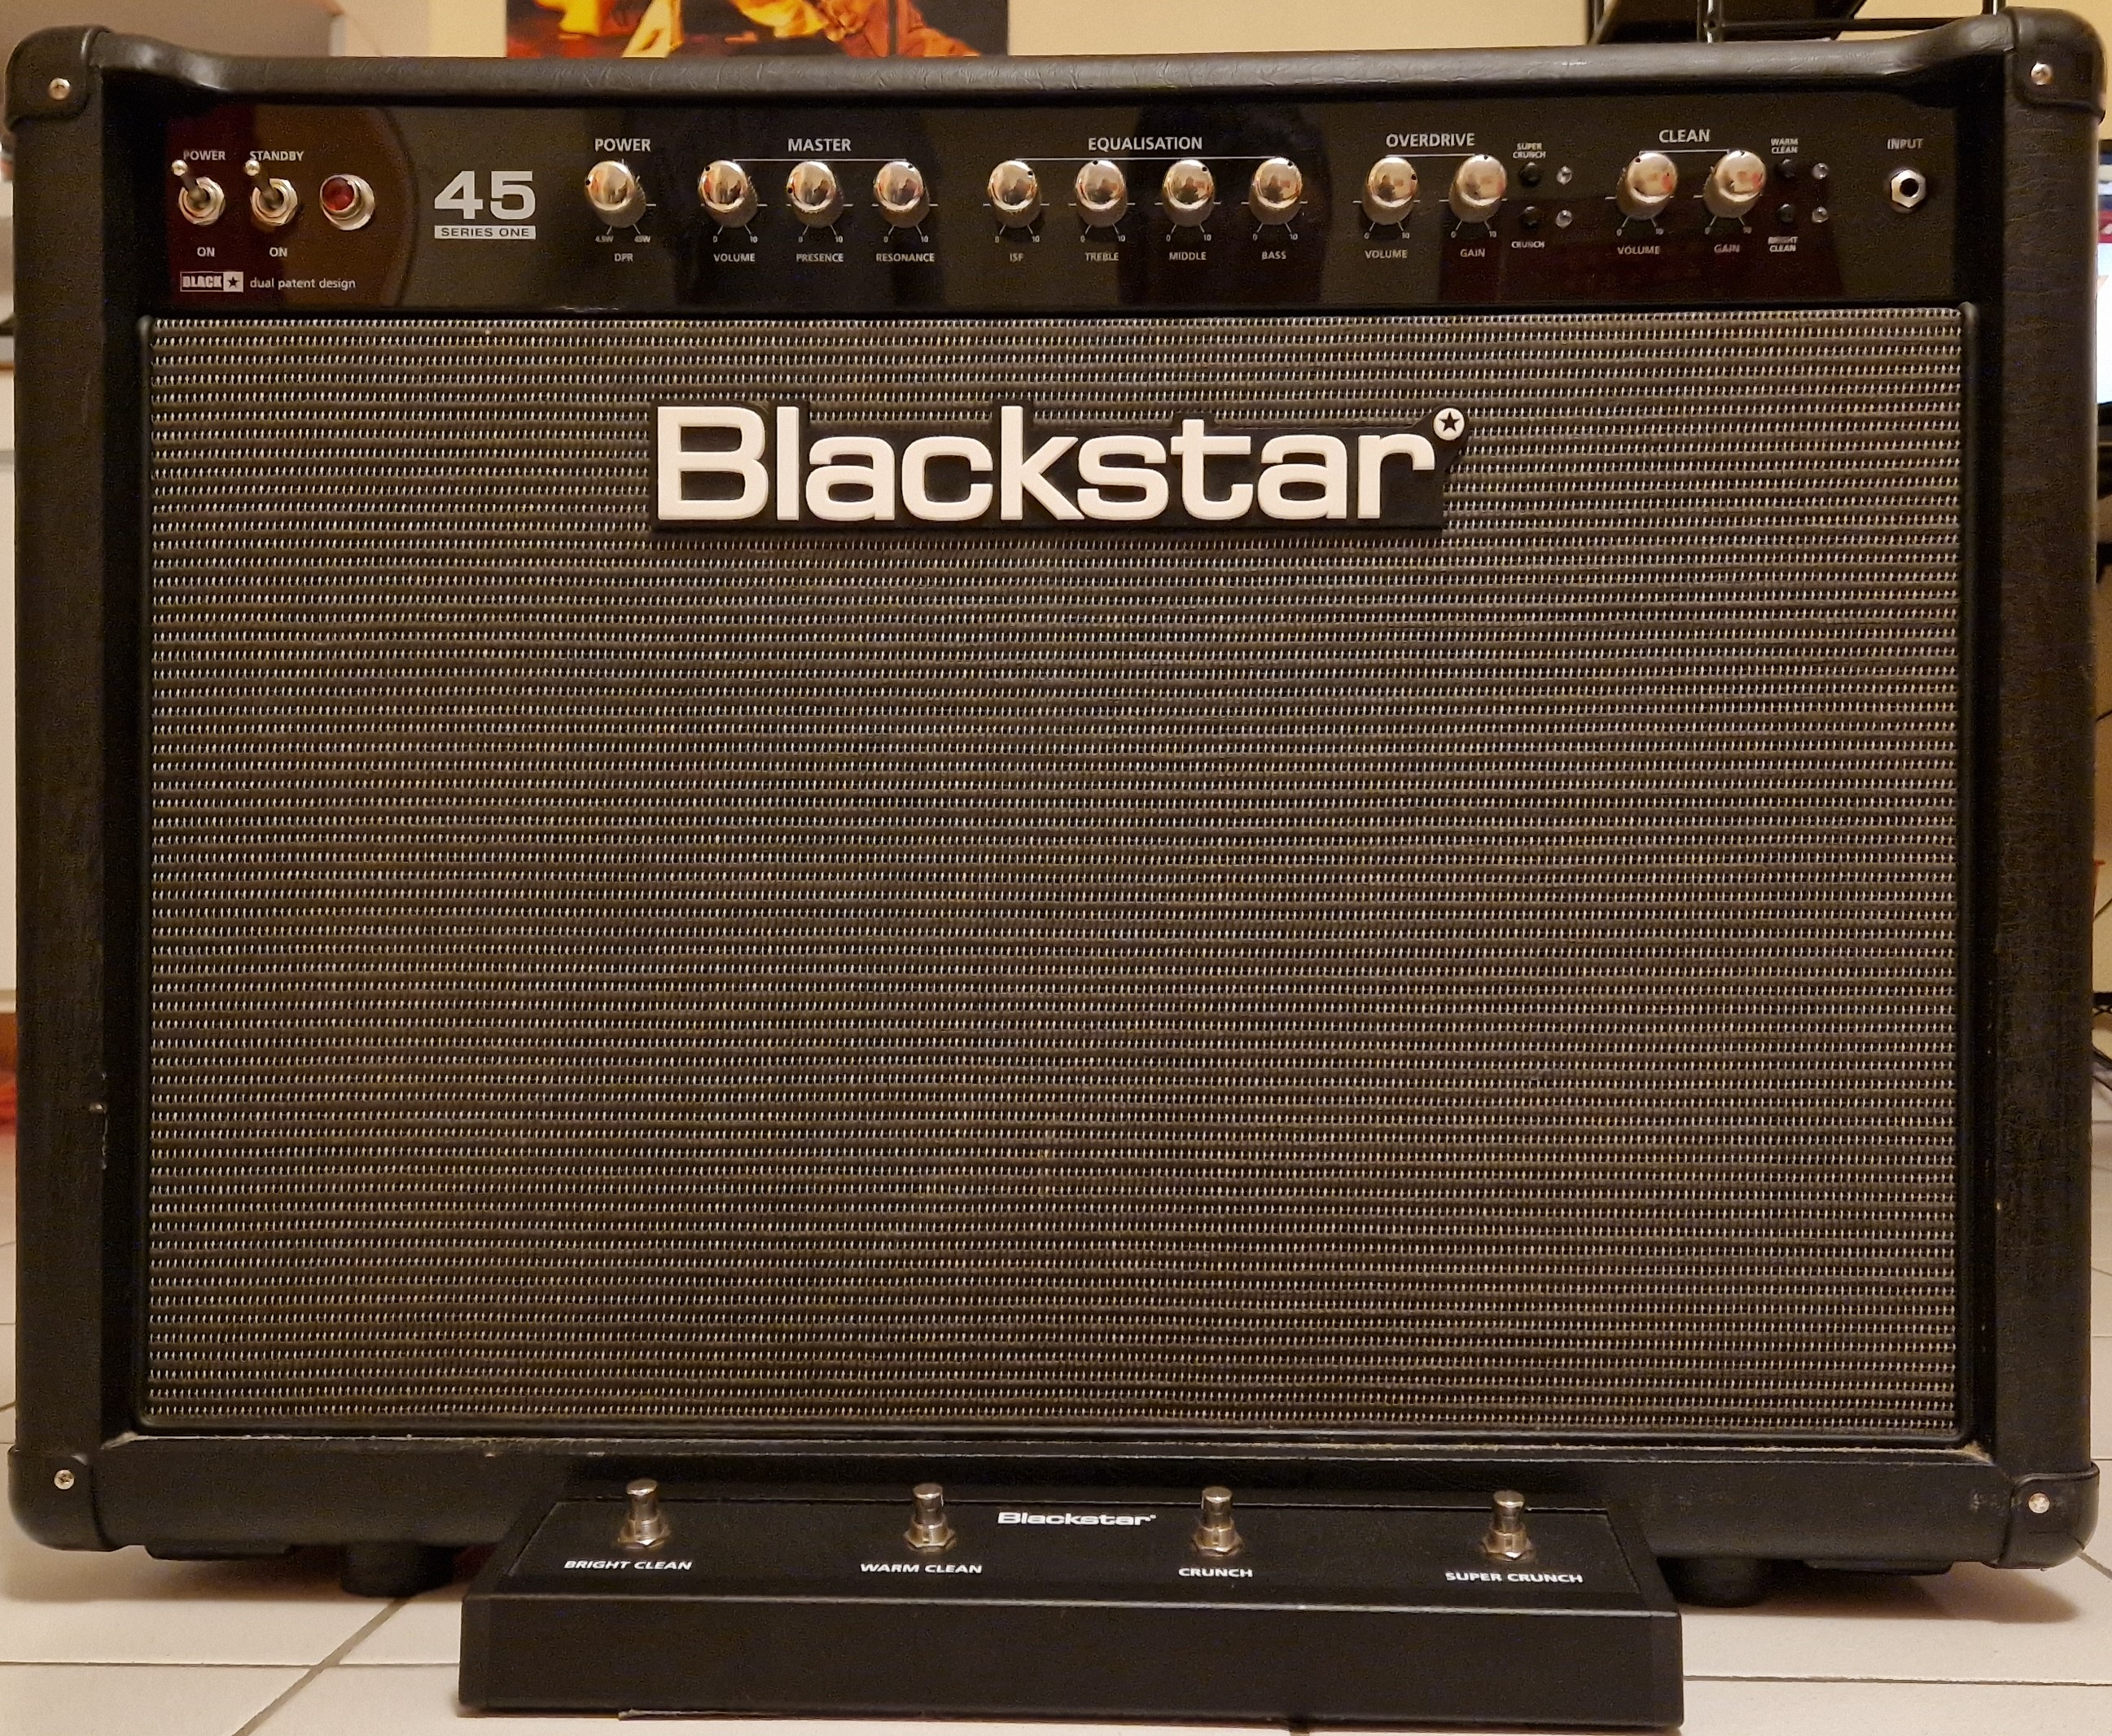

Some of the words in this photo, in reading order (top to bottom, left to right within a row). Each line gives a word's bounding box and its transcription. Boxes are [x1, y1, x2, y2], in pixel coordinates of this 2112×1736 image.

[1386, 133, 1475, 147] OVERDRIVE
[1658, 129, 1711, 143] CLEAN
[594, 138, 651, 152] POWER
[787, 138, 852, 152] MASTER
[1088, 136, 1203, 151] EQUALISATION
[1517, 142, 1542, 151] SUPER
[1770, 138, 1798, 146] WARM
[1886, 138, 1923, 150] INPUT
[183, 150, 226, 161] POWER
[1513, 151, 1545, 159] CRUNCH
[1771, 146, 1798, 154] CLEAN
[249, 151, 304, 162] STANDBY
[434, 170, 536, 220] 45
[440, 227, 493, 238] SERIES
[499, 227, 529, 238] ONE
[196, 247, 215, 257] ON
[269, 247, 287, 257] ON
[1365, 248, 1408, 259] VOLUME
[1460, 248, 1486, 258] GAIN
[1617, 247, 1661, 256] VOLUME
[1714, 244, 1741, 253] GAIN
[614, 252, 633, 262] DPR
[713, 253, 756, 263] VOLUME
[795, 253, 844, 263] PRESENCE
[875, 253, 936, 263] RESONANCE
[1009, 252, 1023, 262] ISF
[1084, 252, 1120, 261] TREBLE
[1169, 251, 1207, 261] MIDDLE
[1261, 250, 1287, 261] BASS
[250, 278, 274, 289] dual
[278, 278, 315, 292] patent
[318, 278, 357, 292] design
[656, 406, 1437, 521] Blackstar
[997, 1511, 1150, 1527] Blackstar
[563, 1560, 630, 1570] BRIGHT
[633, 1561, 693, 1571] CLEAN
[860, 1563, 919, 1573] WARM
[924, 1564, 983, 1574] CLEAN
[1178, 1567, 1254, 1578] CRUNCH
[1445, 1572, 1503, 1582] SUPER
[1507, 1572, 1584, 1584] CRUNCH
